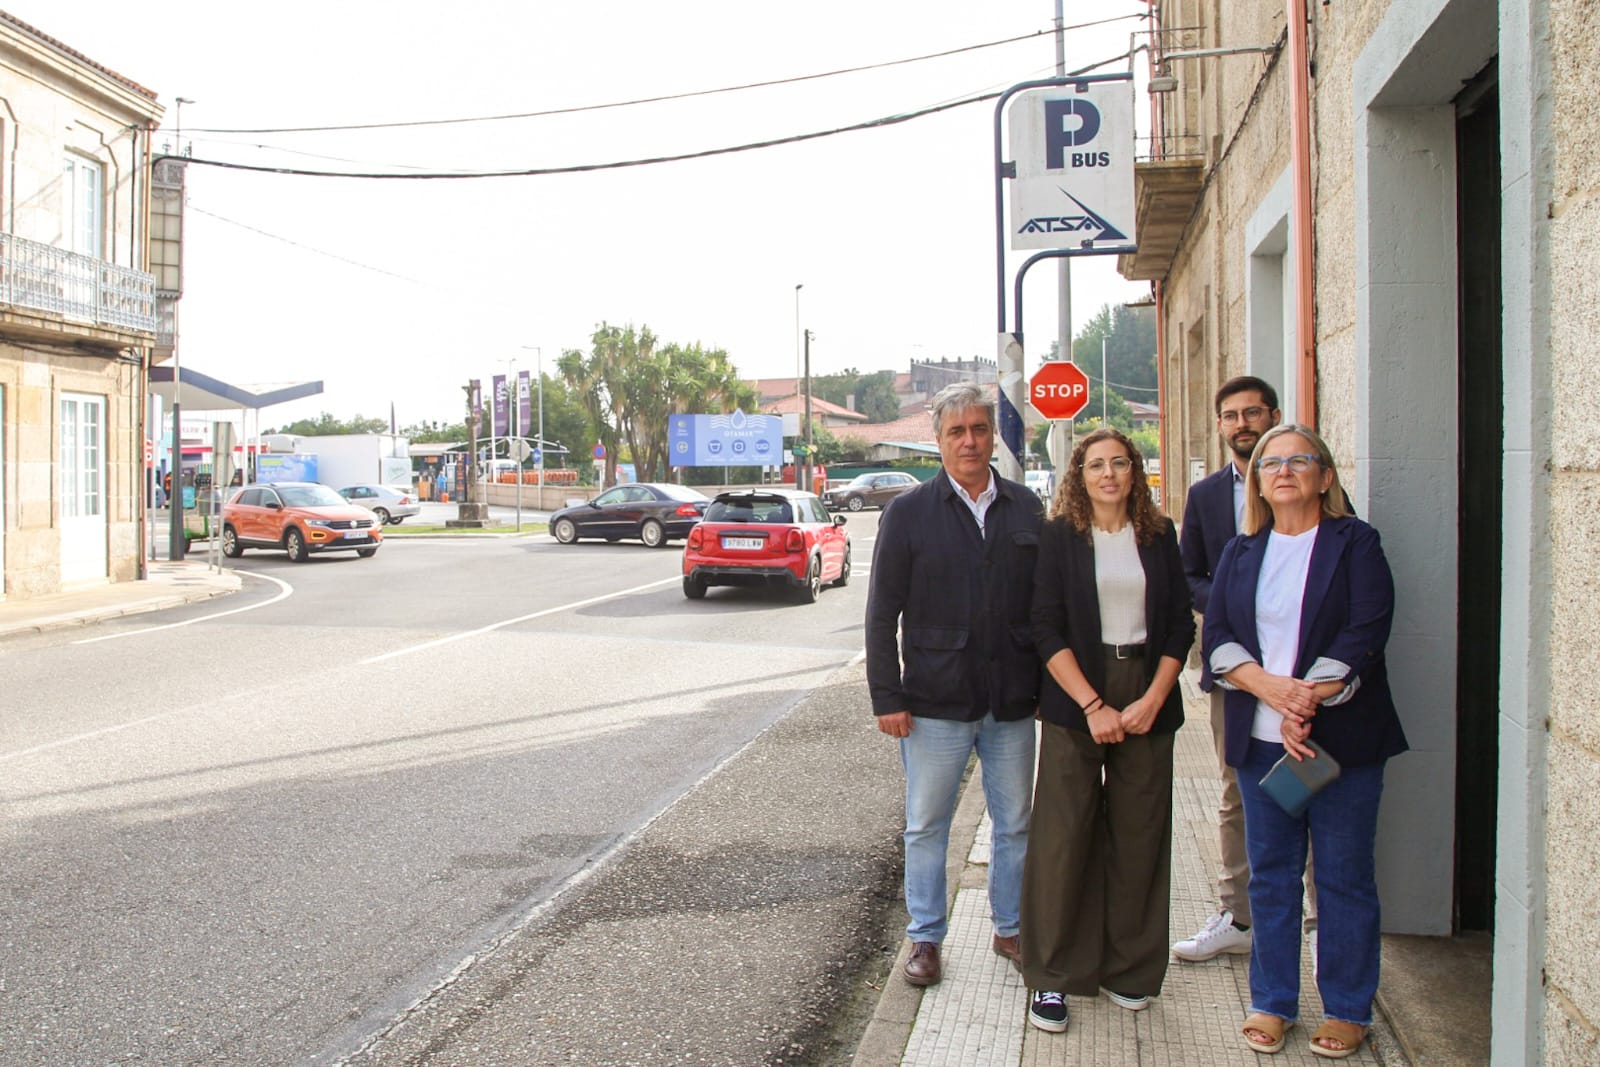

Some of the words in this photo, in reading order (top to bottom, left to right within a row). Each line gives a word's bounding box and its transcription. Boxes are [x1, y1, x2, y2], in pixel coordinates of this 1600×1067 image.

[1044, 97, 1101, 170] P
[1071, 151, 1110, 168] BUS
[1017, 215, 1105, 234] ATSA
[1034, 383, 1084, 398] STOP
